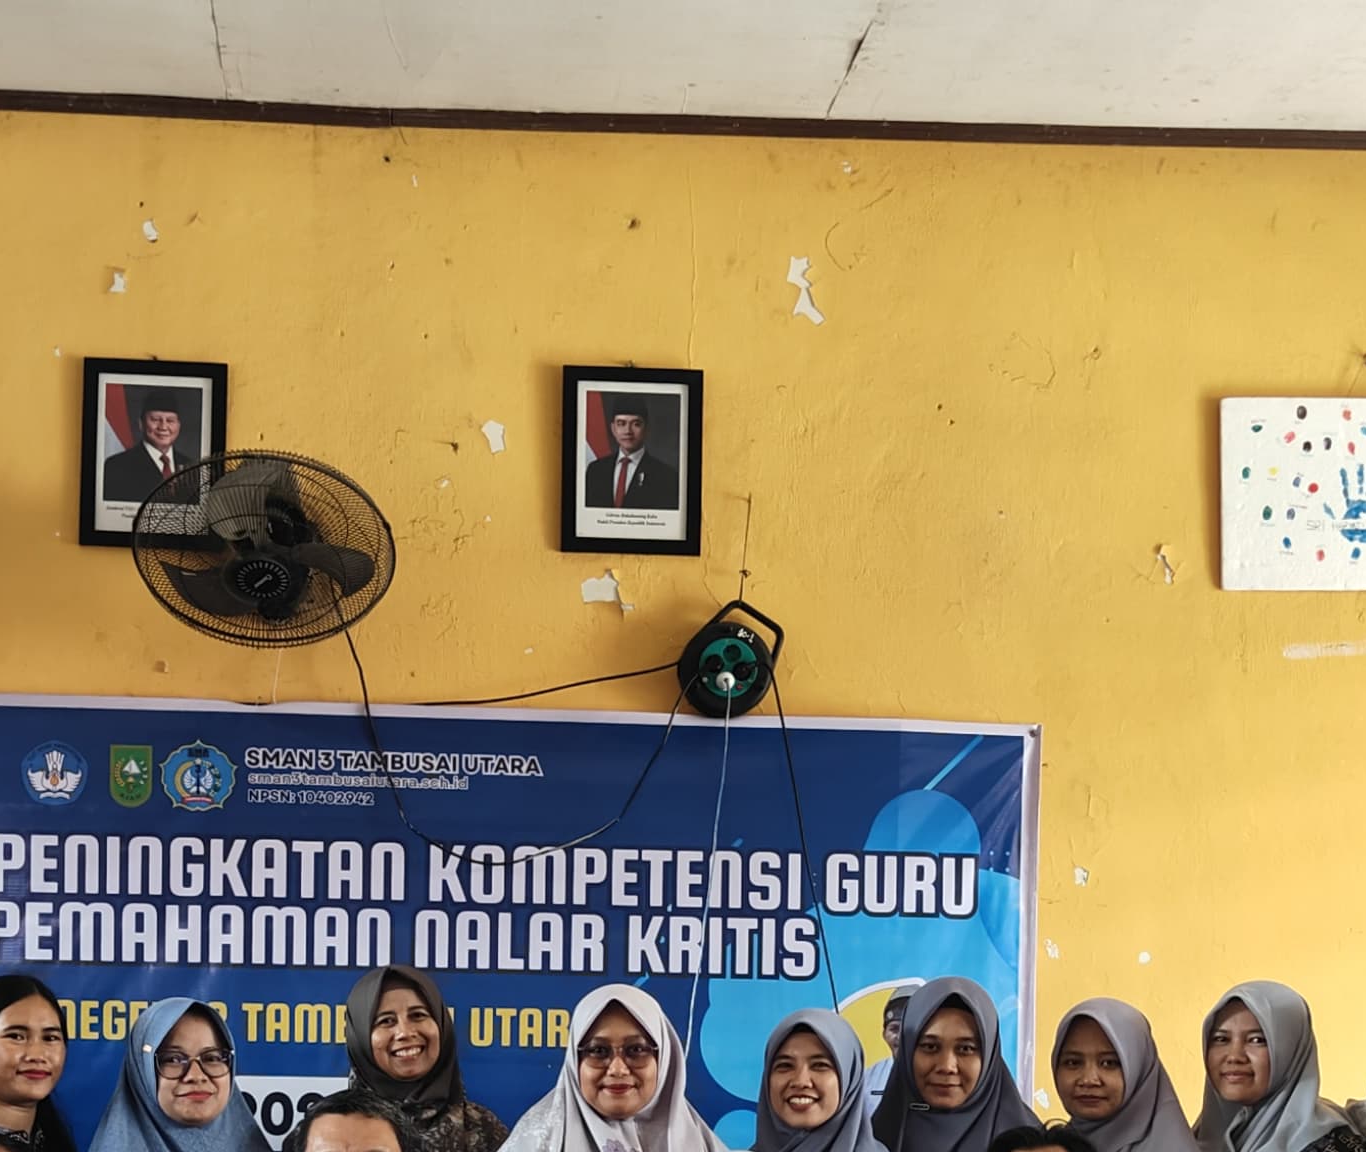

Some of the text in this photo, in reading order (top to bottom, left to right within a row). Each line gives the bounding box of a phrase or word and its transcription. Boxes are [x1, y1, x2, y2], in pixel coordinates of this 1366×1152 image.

[245, 747, 544, 777] SMAN 3 TAMBUSAI UTARA
[248, 788, 375, 805] NPSN: 10402942
[428, 843, 802, 911] KOMPETENSI
[824, 852, 976, 916] GURU
[414, 909, 605, 972] NALAR
[627, 915, 816, 978] KRITIS
[470, 1007, 571, 1048] UTAR
